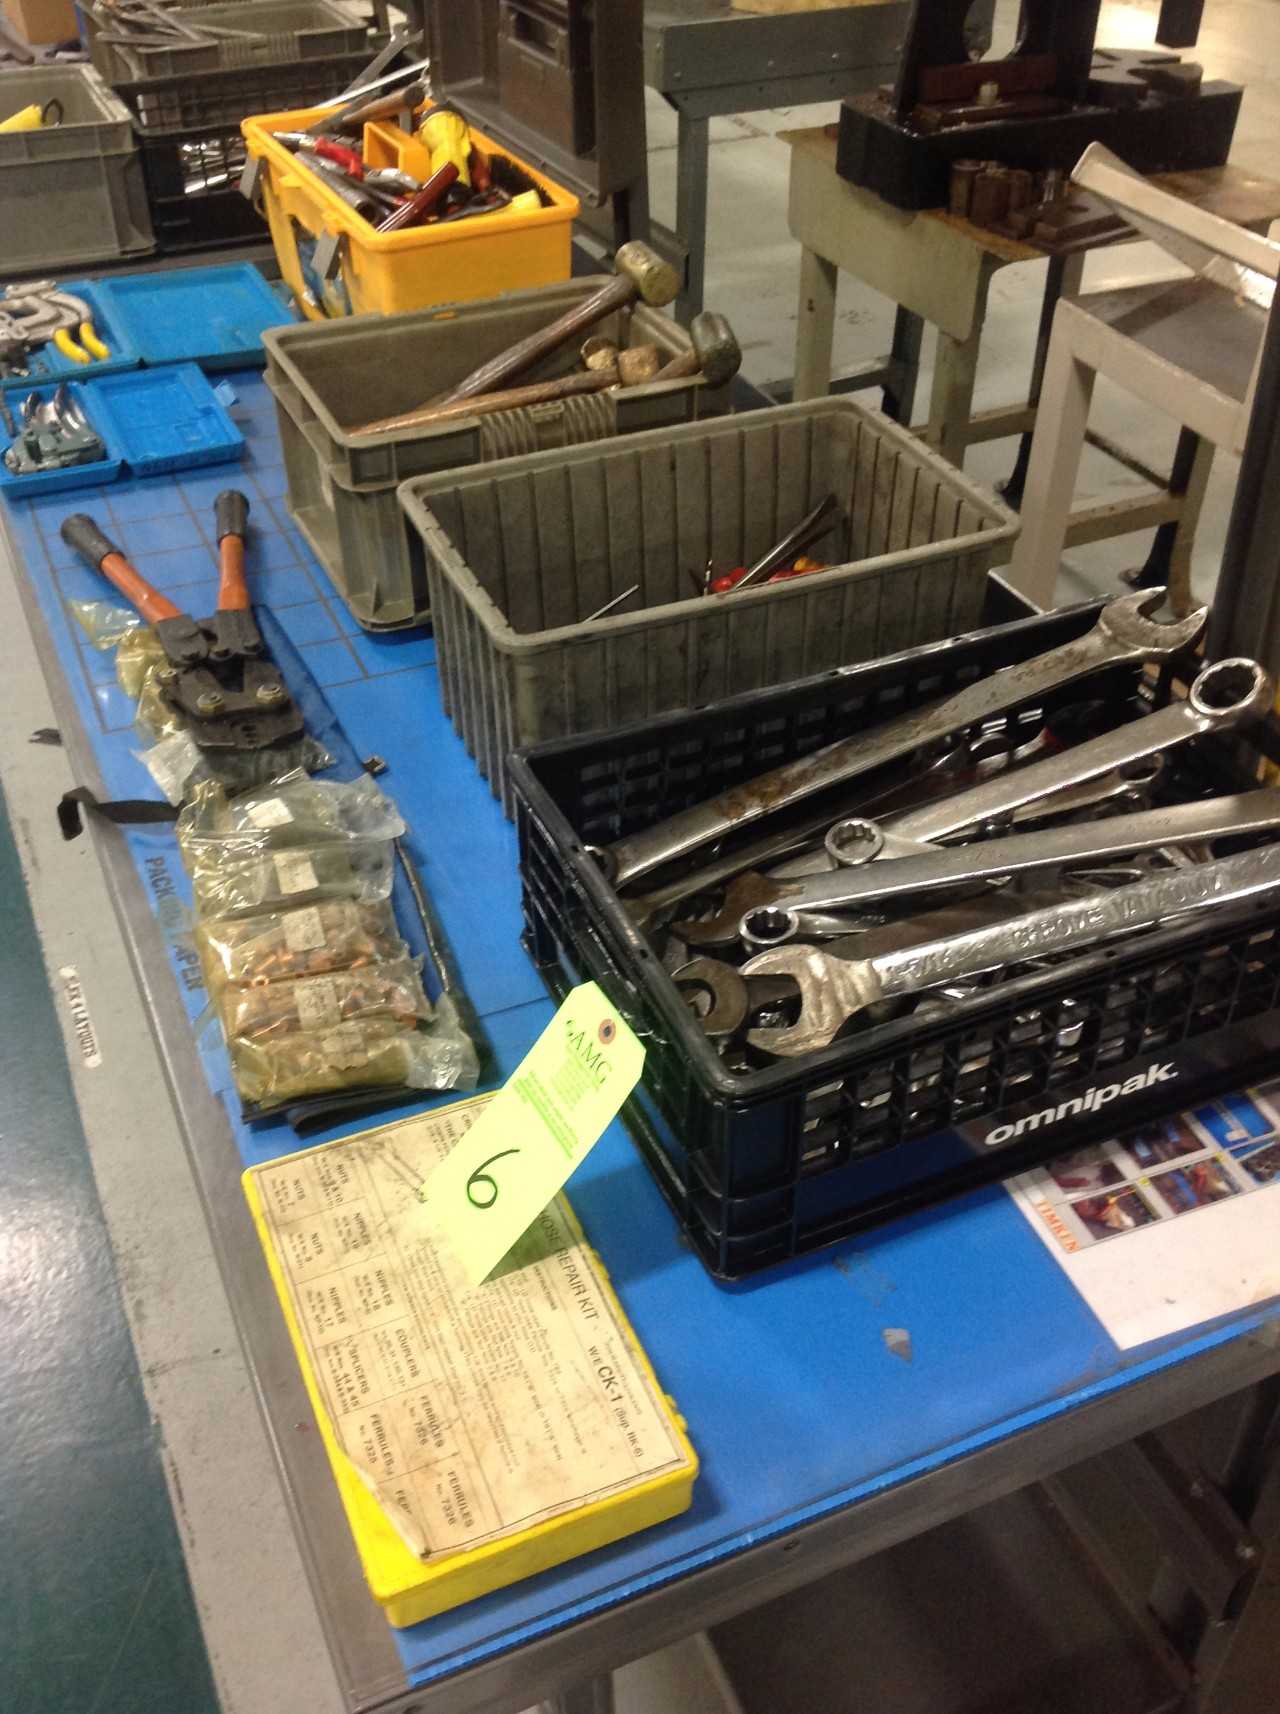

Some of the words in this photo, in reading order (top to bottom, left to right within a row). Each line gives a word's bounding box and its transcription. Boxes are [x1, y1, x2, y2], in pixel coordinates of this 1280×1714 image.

[466, 1149, 520, 1209] 6
[558, 1247, 585, 1297] REPAIR
[579, 1297, 599, 1321] KIT
[396, 1329, 420, 1378] COUPLERS
[598, 1365, 623, 1402] CK-1
